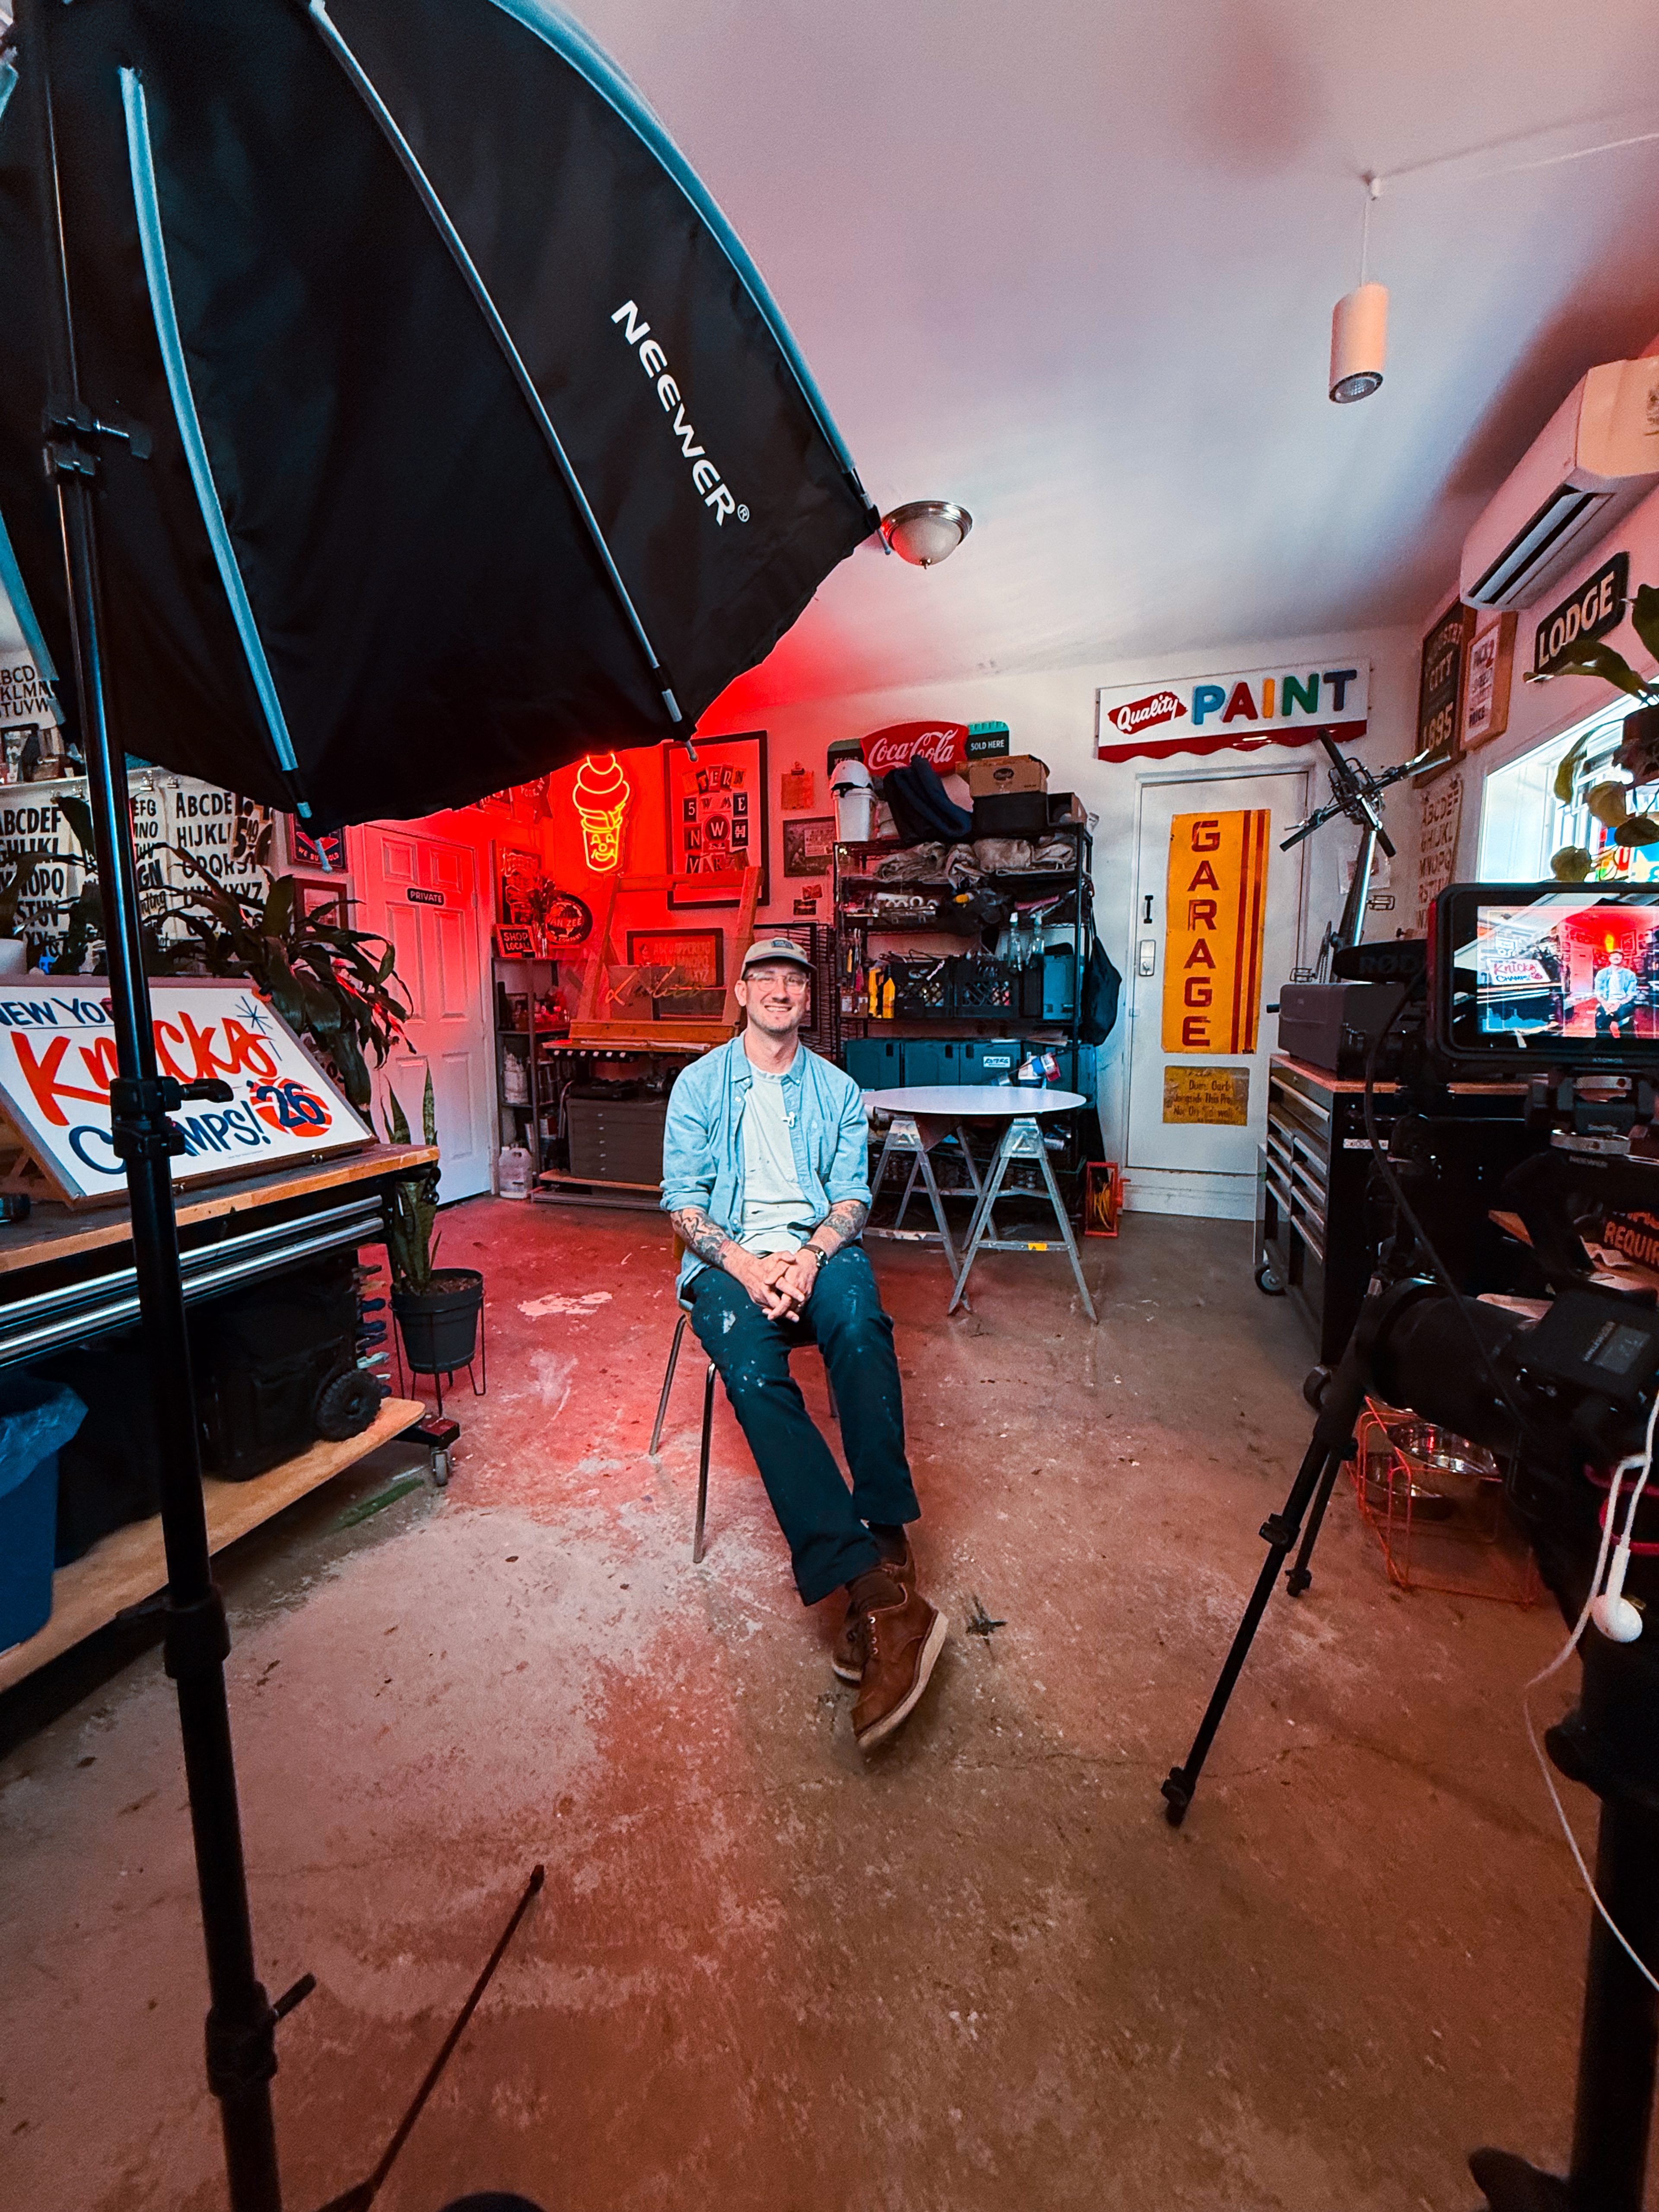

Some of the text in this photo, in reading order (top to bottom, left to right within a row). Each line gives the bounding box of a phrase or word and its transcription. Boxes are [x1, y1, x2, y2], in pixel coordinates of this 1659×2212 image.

[1540, 571, 1616, 664] LODGE
[0, 665, 35, 685] BCD
[1429, 650, 1453, 691] CITY
[1116, 669, 1357, 731] Quality PAINT
[868, 728, 958, 770] Coca-Cola
[970, 739, 1005, 751] SOLD HERE
[0, 807, 61, 836] BCDEF
[410, 890, 442, 903] PRIVATE
[503, 932, 528, 941] SHOP
[566, 918, 582, 927] ZEE
[1182, 820, 1220, 1046] GARAGE
[505, 942, 530, 951] LOCAL!
[11, 1011, 277, 1126] Kncks
[68, 1100, 271, 1175] CMPS!
